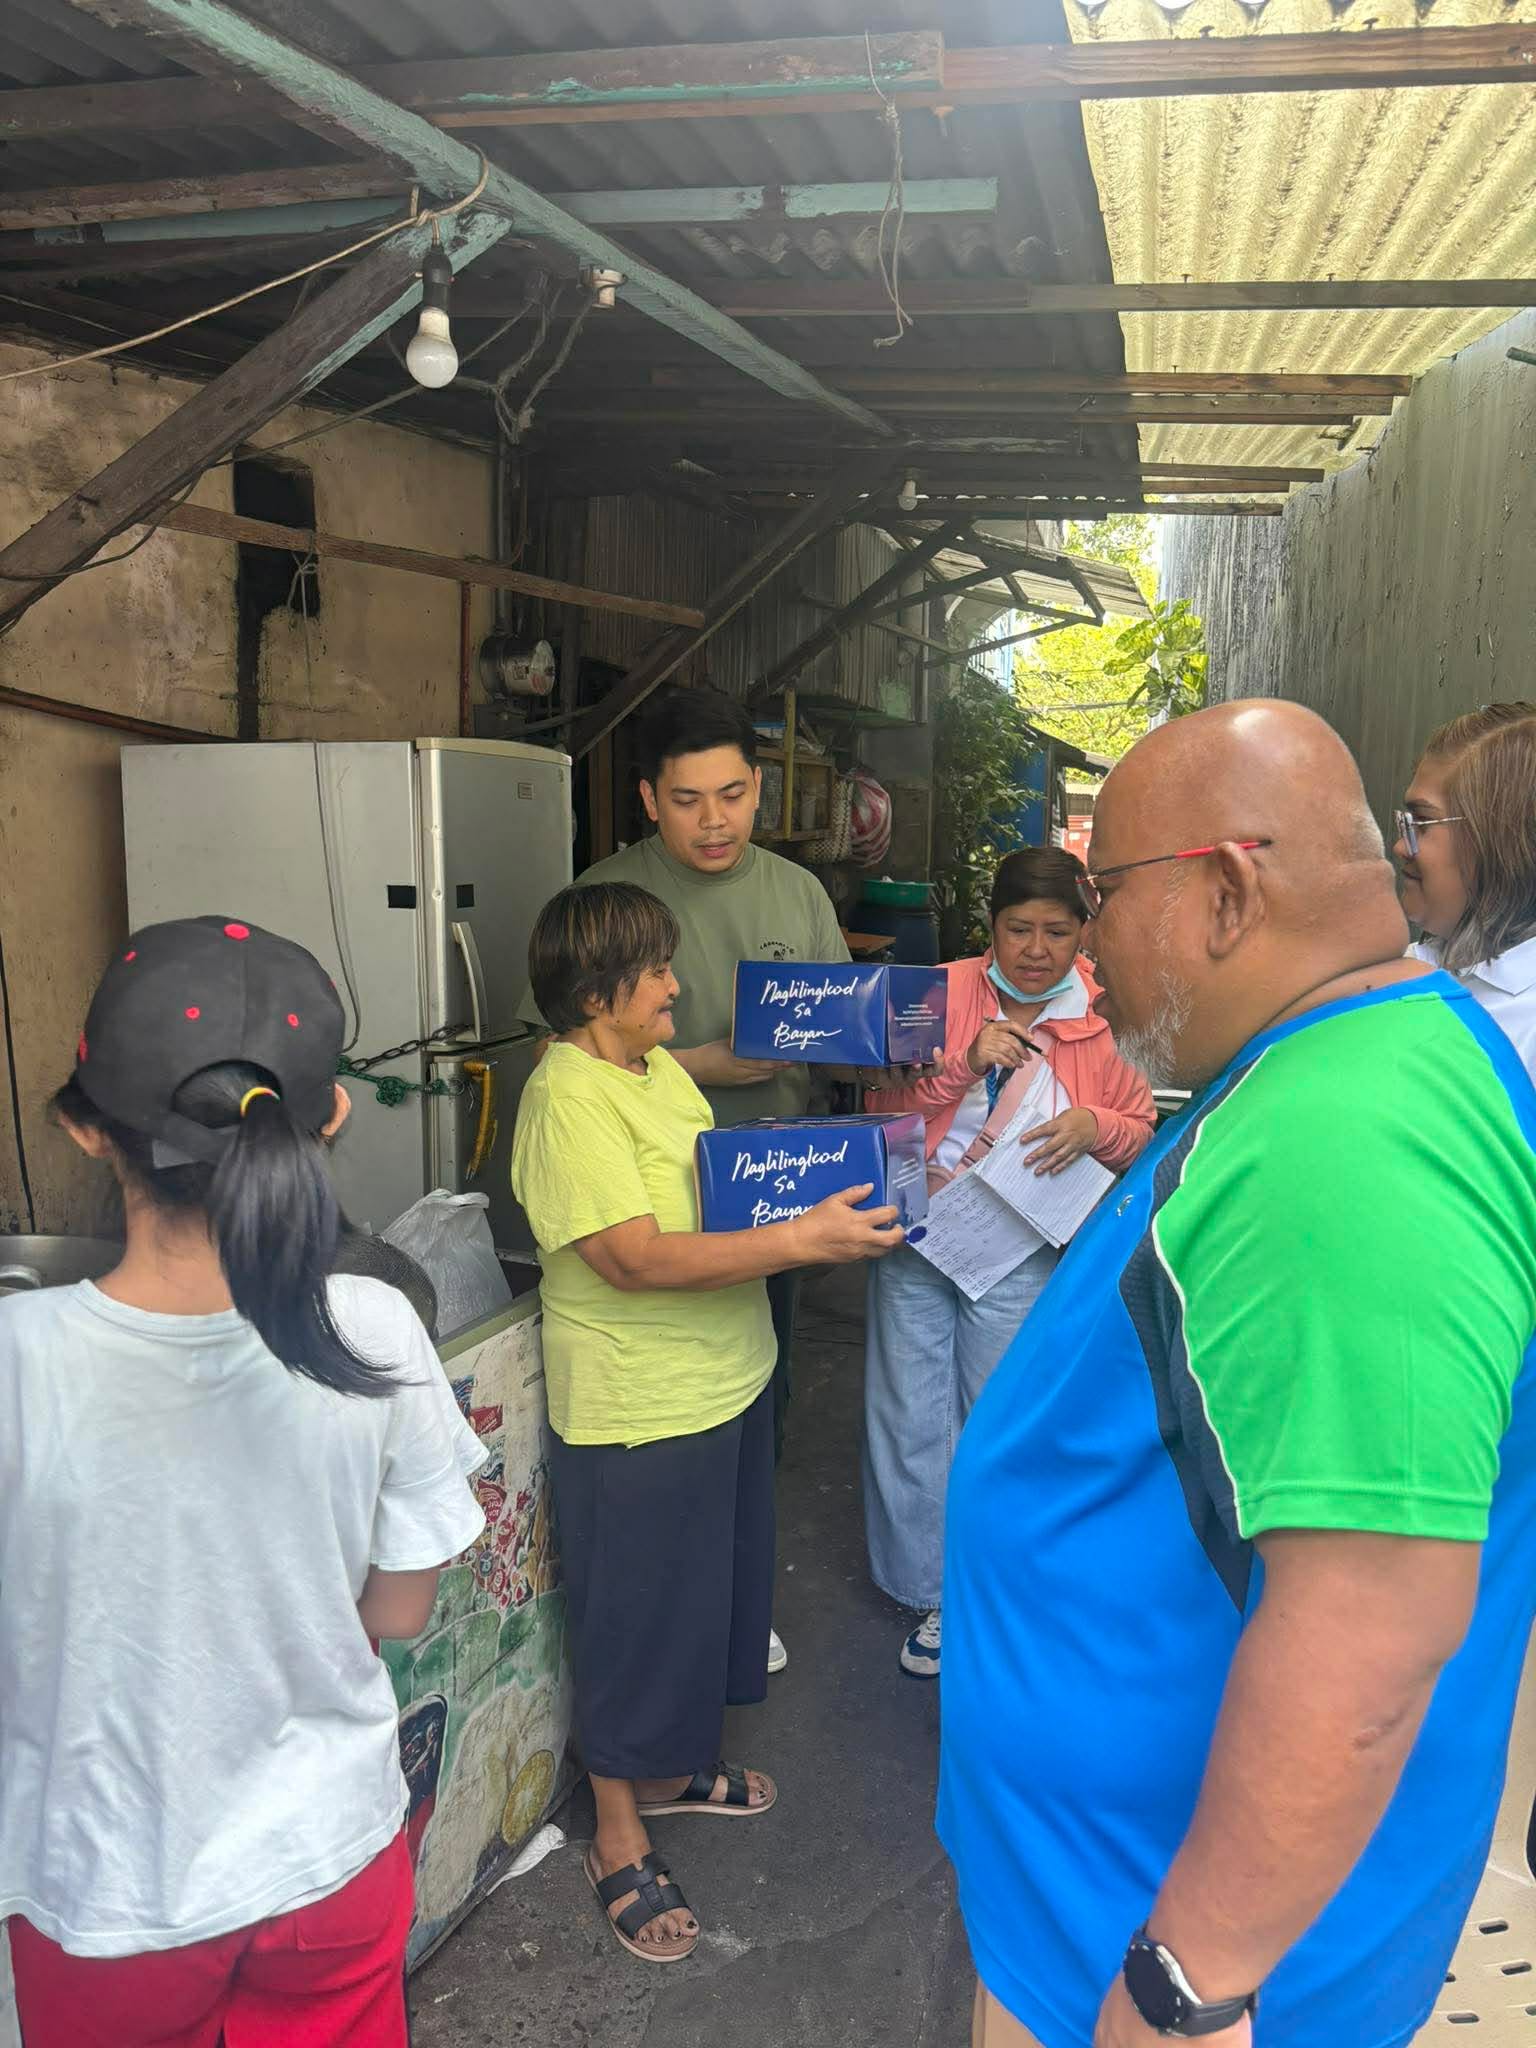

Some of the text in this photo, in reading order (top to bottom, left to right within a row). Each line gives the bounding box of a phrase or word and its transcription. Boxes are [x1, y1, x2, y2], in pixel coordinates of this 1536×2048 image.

[760, 976, 859, 1006] Naglilingkod
[773, 1021, 843, 1050] Bayan
[731, 1140, 848, 1182] Naglilingkod
